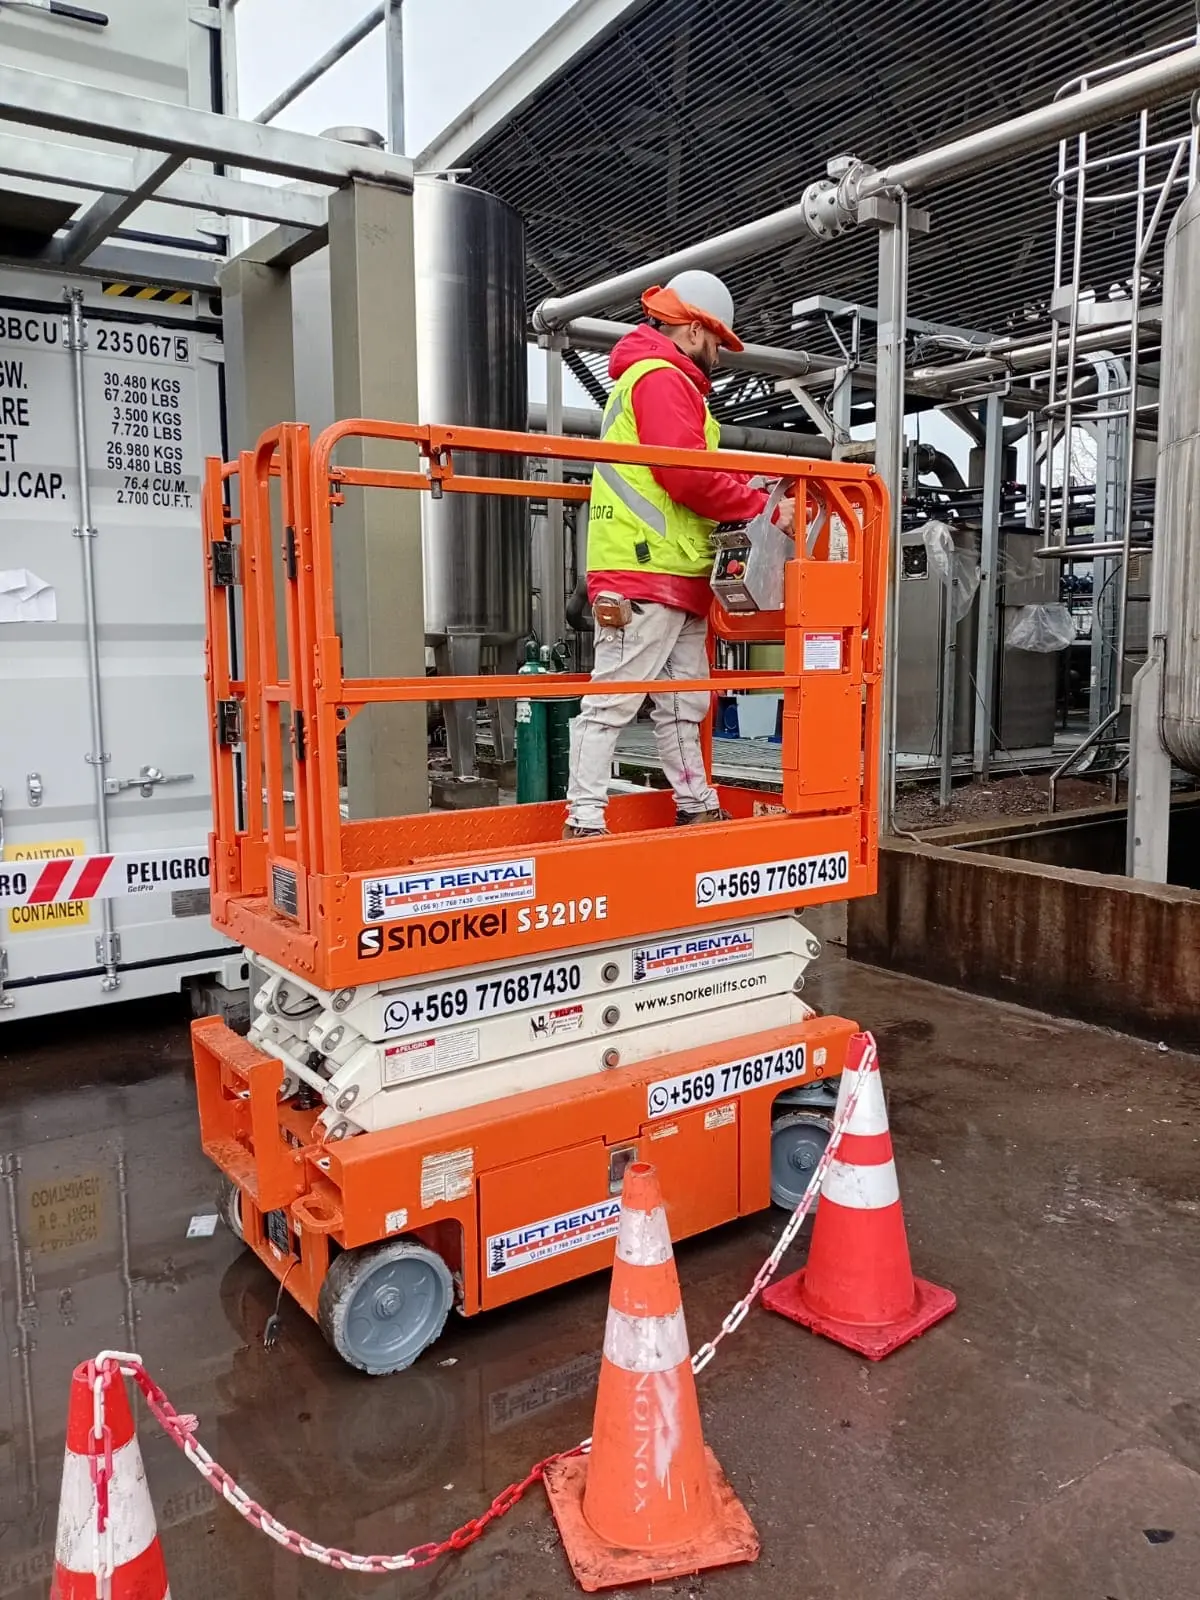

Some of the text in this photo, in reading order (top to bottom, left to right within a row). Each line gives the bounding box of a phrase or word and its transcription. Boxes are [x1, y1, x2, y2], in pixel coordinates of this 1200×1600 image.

[104, 372, 181, 393] 30.480 KGS
[104, 388, 179, 408] 67.200 LBS
[113, 407, 182, 426] 3.500 KGS
[112, 422, 182, 441] 7.720 LBS
[106, 441, 183, 461] 26.980 KGS
[107, 457, 182, 475] 59.480 LBS
[124, 476, 188, 493] 76.4 CU.M.
[117, 490, 149, 505] 2.700
[126, 856, 210, 884] PELIGRO
[384, 865, 532, 897] LIFT RENTAL
[717, 855, 847, 898] +569 77687430
[12, 900, 84, 924] CONTAINER
[388, 908, 508, 952] snorkel
[516, 895, 608, 933] S3219E
[646, 933, 752, 961] LIFT RENTAL
[411, 964, 581, 1023] +569 77687430
[634, 973, 767, 1012] www.snorkellifts.com
[670, 1073, 715, 1105] +569
[721, 1047, 804, 1092] 77687430
[506, 1226, 551, 1249] LIFT
